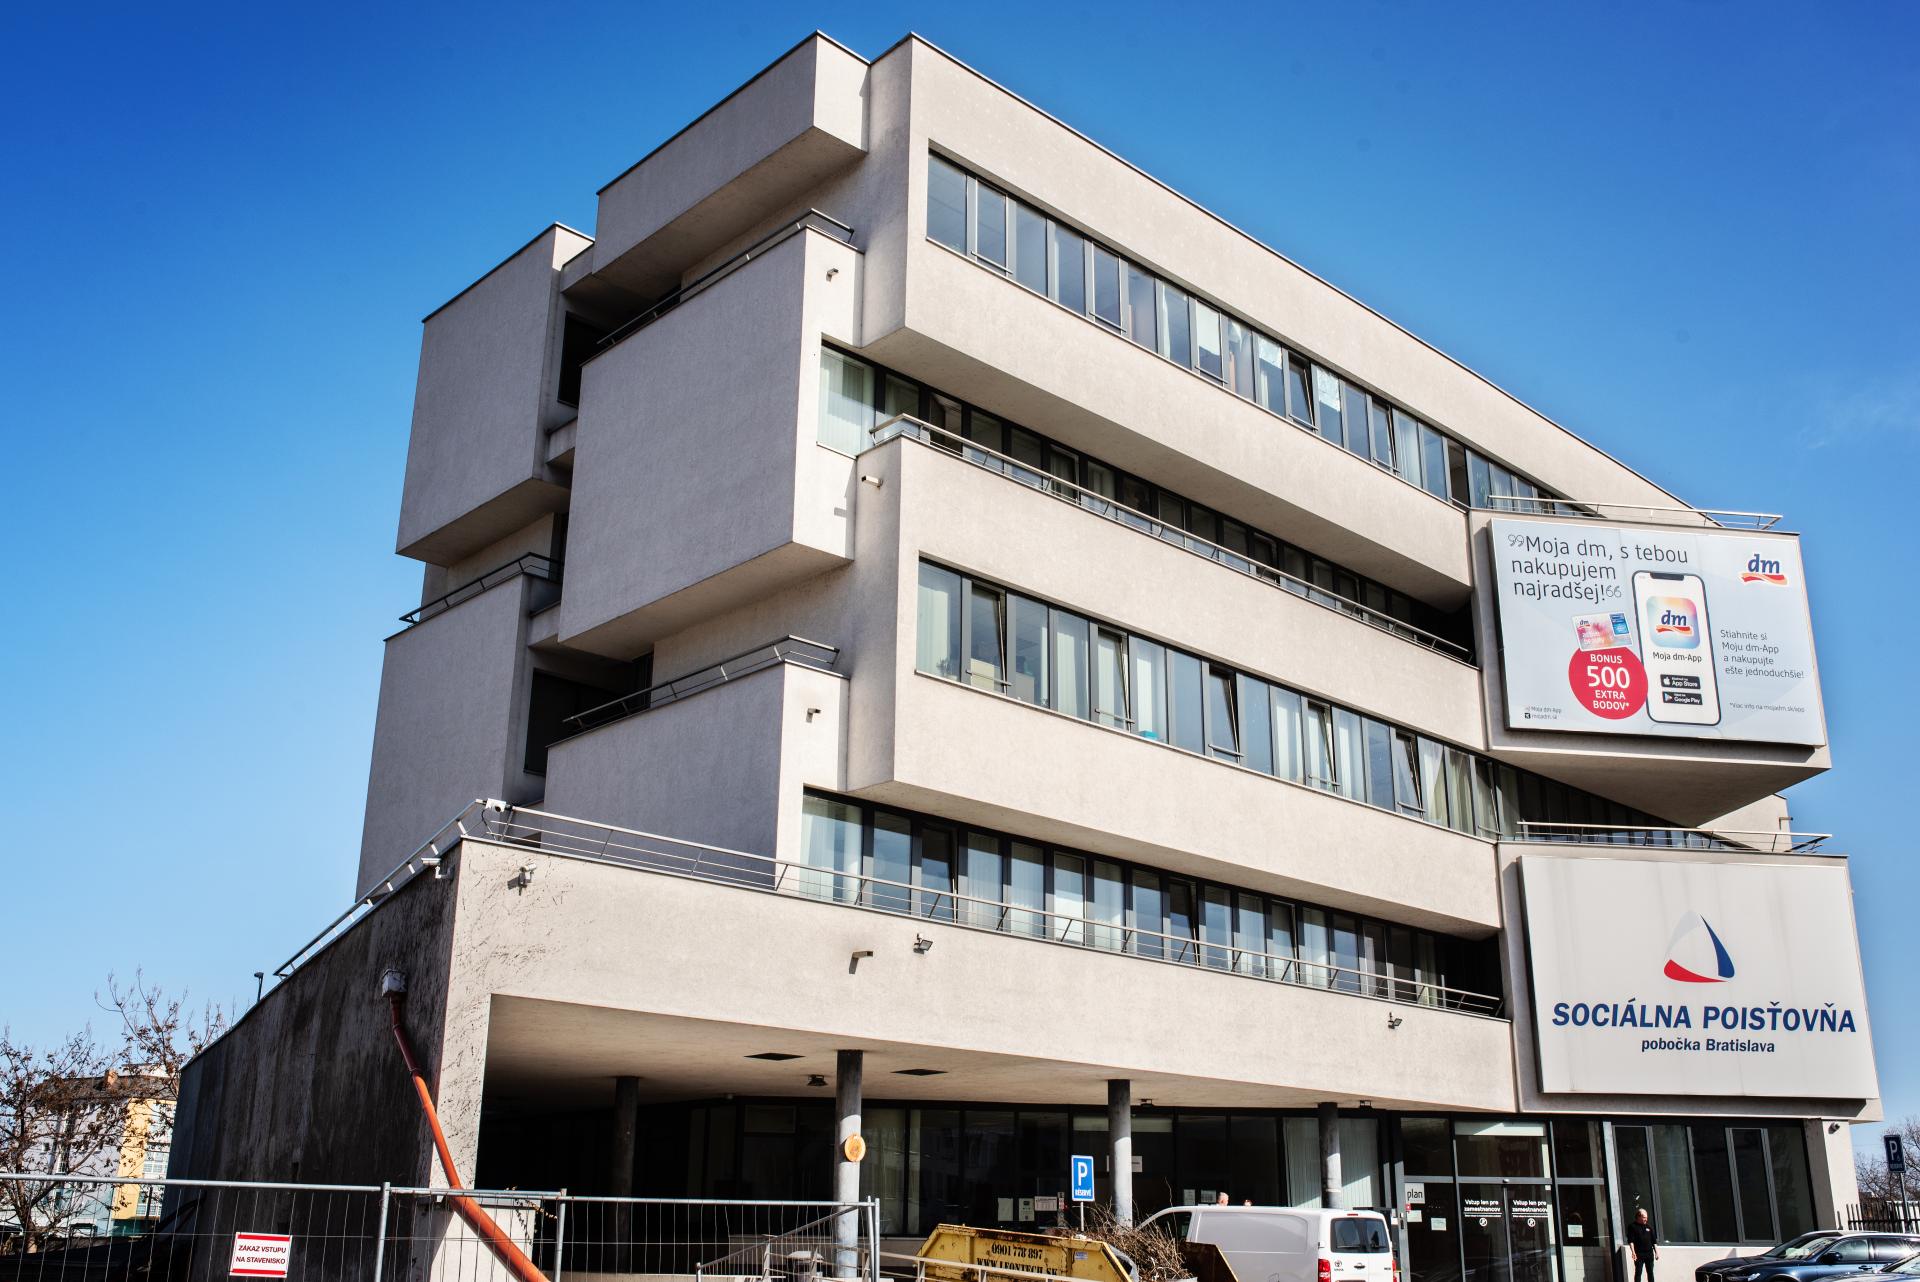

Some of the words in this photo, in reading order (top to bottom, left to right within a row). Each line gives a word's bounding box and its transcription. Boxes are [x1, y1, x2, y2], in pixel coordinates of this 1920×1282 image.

[1577, 539, 1612, 560] dm,
[1621, 546, 1629, 559] s
[1635, 544, 1687, 563] tebou
[1512, 558, 1616, 581] nakupujem
[1748, 553, 1780, 574] dm
[1661, 610, 1687, 626] dm
[1720, 630, 1758, 640] Stiahnite
[1760, 633, 1767, 641] si
[1722, 642, 1743, 652] Moju
[1745, 644, 1779, 654] dm-App
[1590, 654, 1622, 663] BONUS
[1653, 651, 1671, 661] Moja
[1673, 652, 1702, 663] dm-App
[1731, 655, 1774, 666] nakupujte
[1587, 665, 1630, 688] 500
[1725, 667, 1743, 675] ešte
[1595, 690, 1626, 699] EXTRA
[1674, 696, 1691, 704] Google
[1552, 997, 1692, 1028] SOCIÁLNA
[1703, 1001, 1856, 1032] POISŤOVŇA
[1641, 1037, 1700, 1052] pobočka
[1706, 1038, 1775, 1052] Bratislava
[1889, 1140, 1897, 1160] P
[1078, 1161, 1088, 1186] P
[1407, 1188, 1423, 1201] plan
[992, 1243, 1011, 1255] 0901
[1013, 1246, 1027, 1257] 778
[1028, 1248, 1042, 1259] 897
